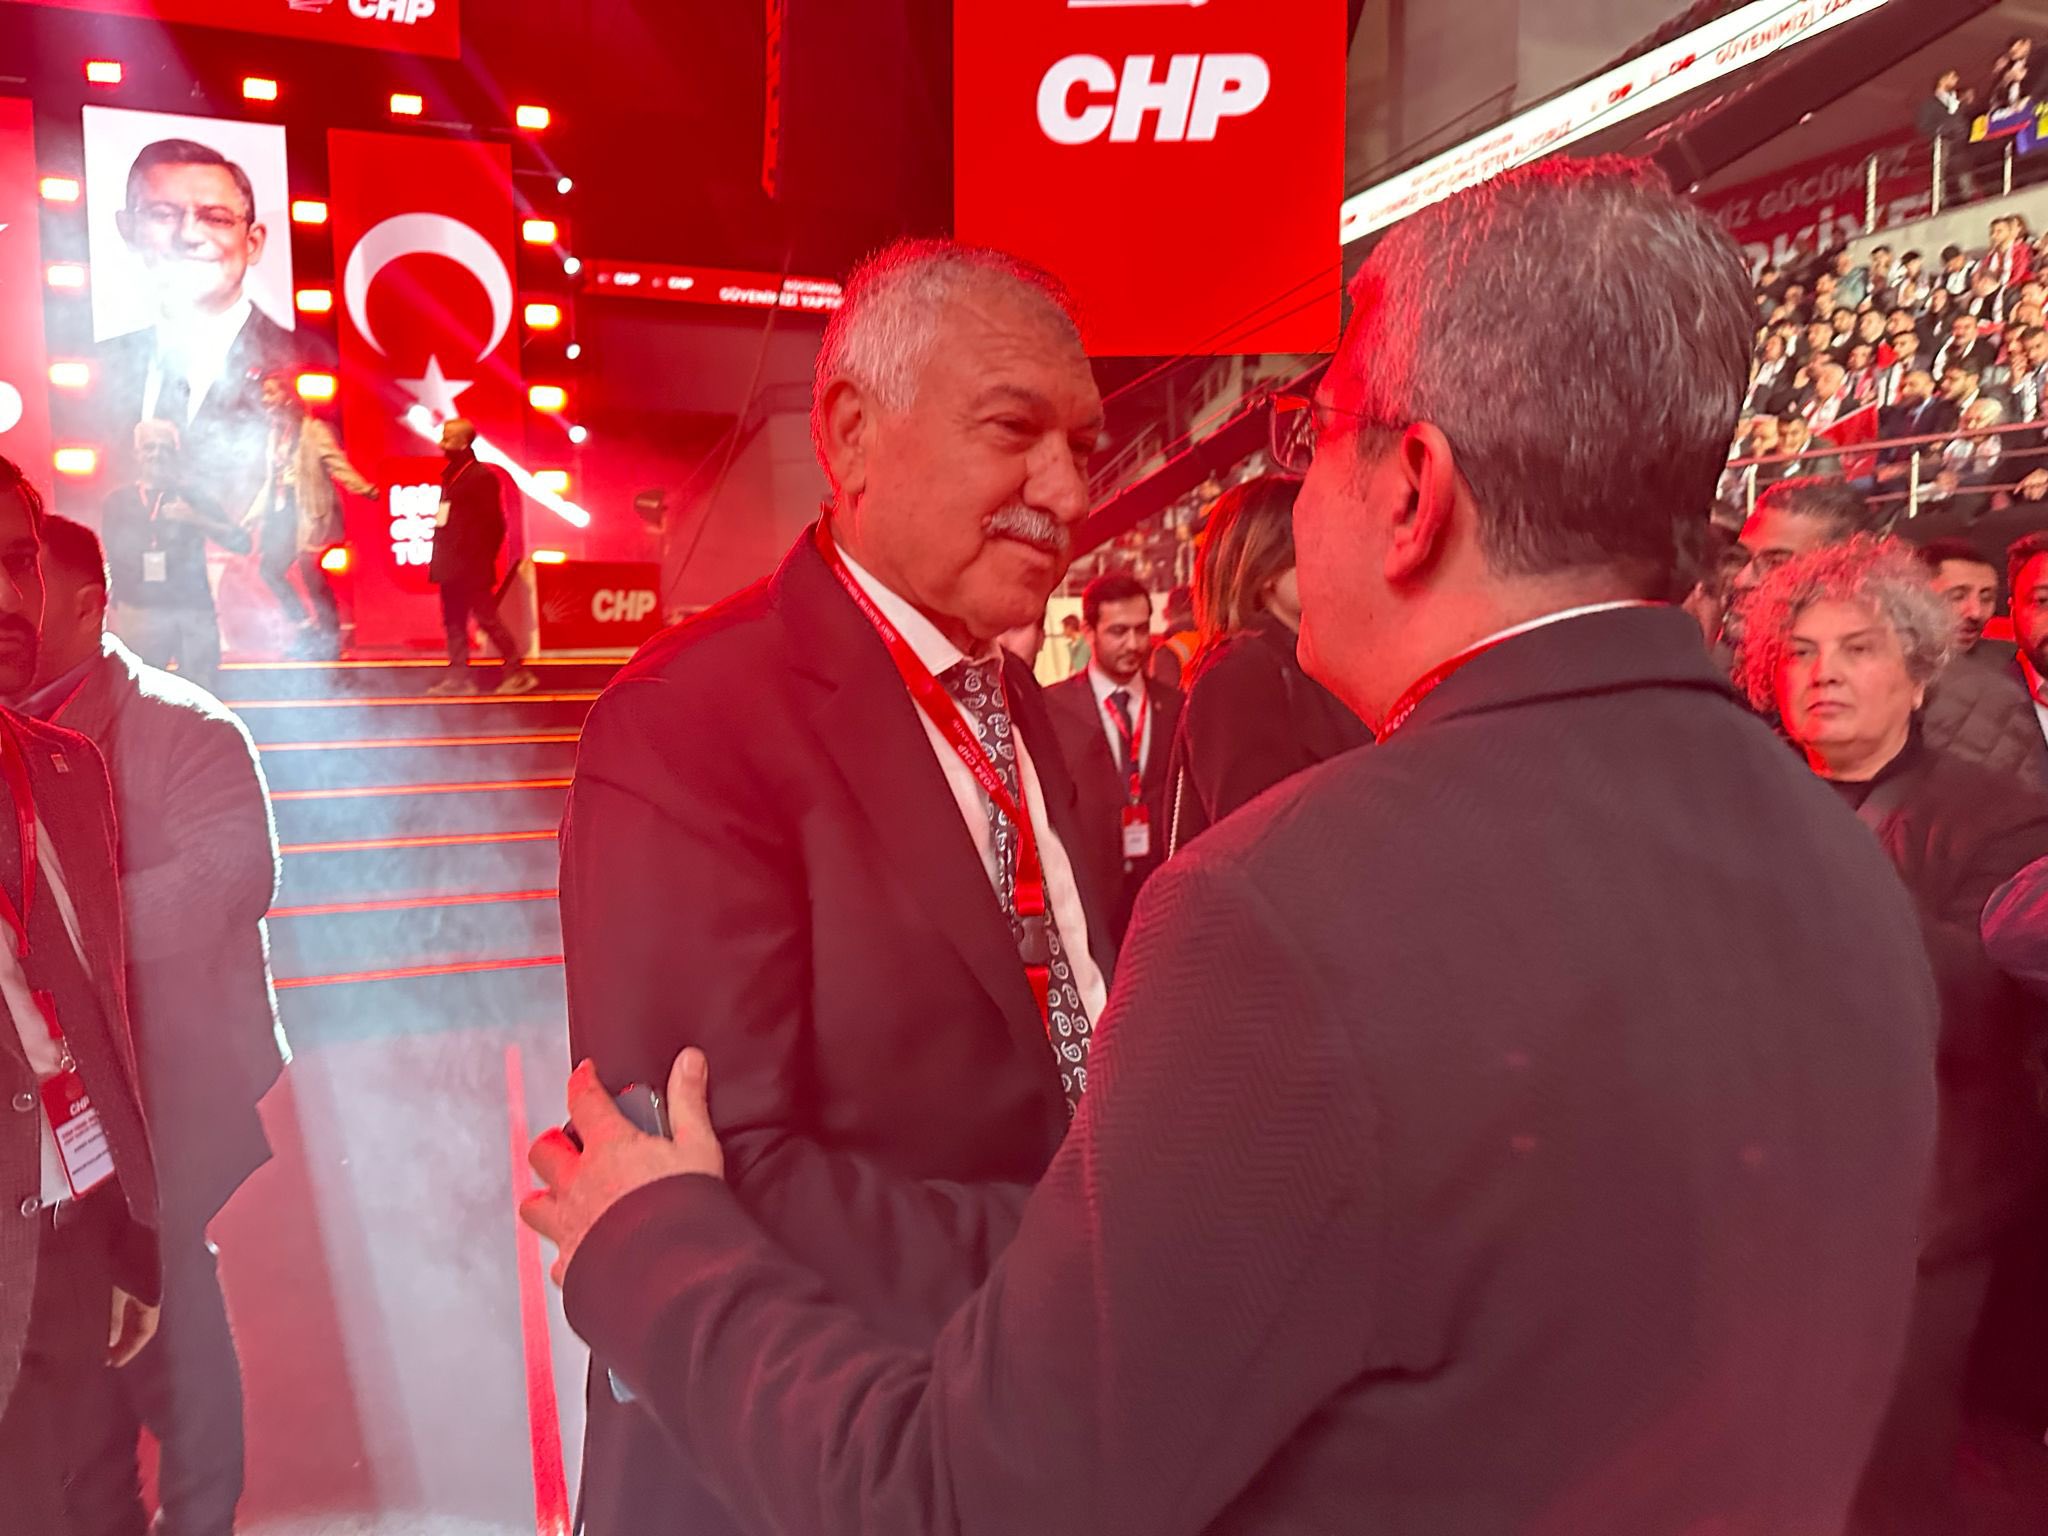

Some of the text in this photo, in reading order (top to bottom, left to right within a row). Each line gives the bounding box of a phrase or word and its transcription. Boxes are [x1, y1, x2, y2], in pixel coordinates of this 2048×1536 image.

[1036, 53, 1270, 145] CHP
[591, 589, 657, 623] CHP
[956, 743, 997, 792] 2024 CHP
